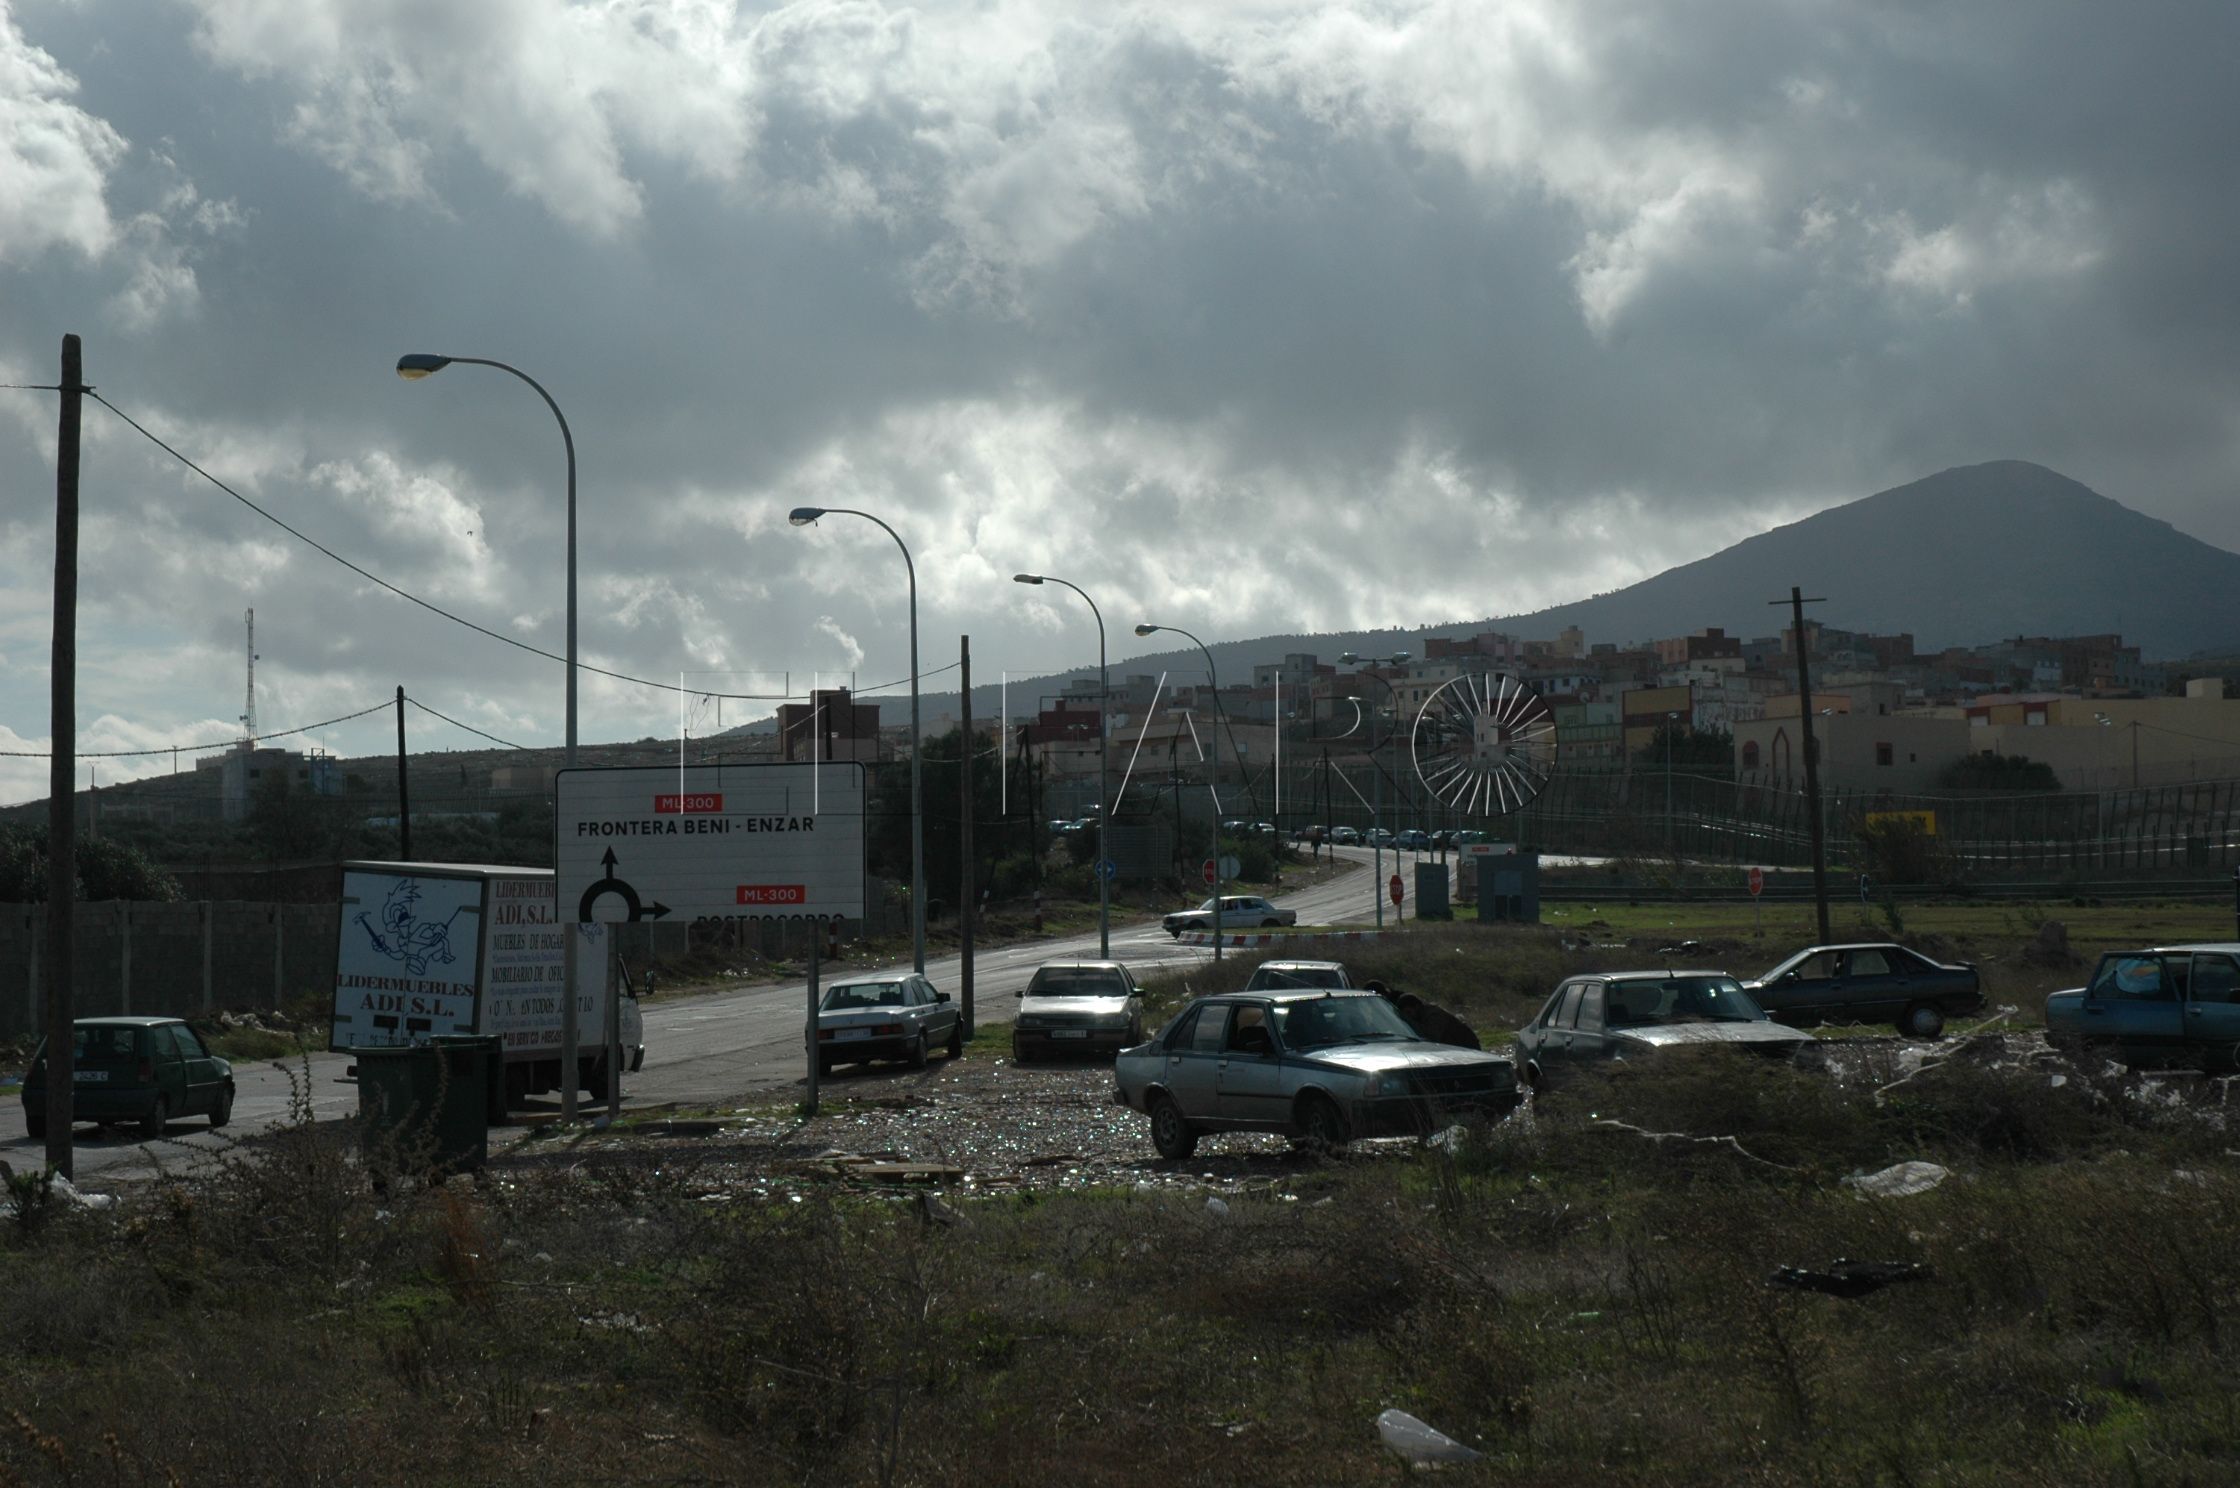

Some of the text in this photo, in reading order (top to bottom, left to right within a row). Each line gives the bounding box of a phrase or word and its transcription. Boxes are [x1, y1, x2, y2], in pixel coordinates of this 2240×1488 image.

[662, 797, 714, 809] ML-300
[578, 820, 678, 837] FRONTERA
[684, 819, 730, 835] BENI
[747, 817, 814, 833] ENZAR
[744, 888, 797, 902] ML-300
[493, 933, 526, 950] MUEBLES
[529, 933, 540, 950] DE
[490, 966, 533, 983] MOBILIARIO
[533, 966, 544, 982] DE
[338, 974, 474, 997] LIDERMUEBLES
